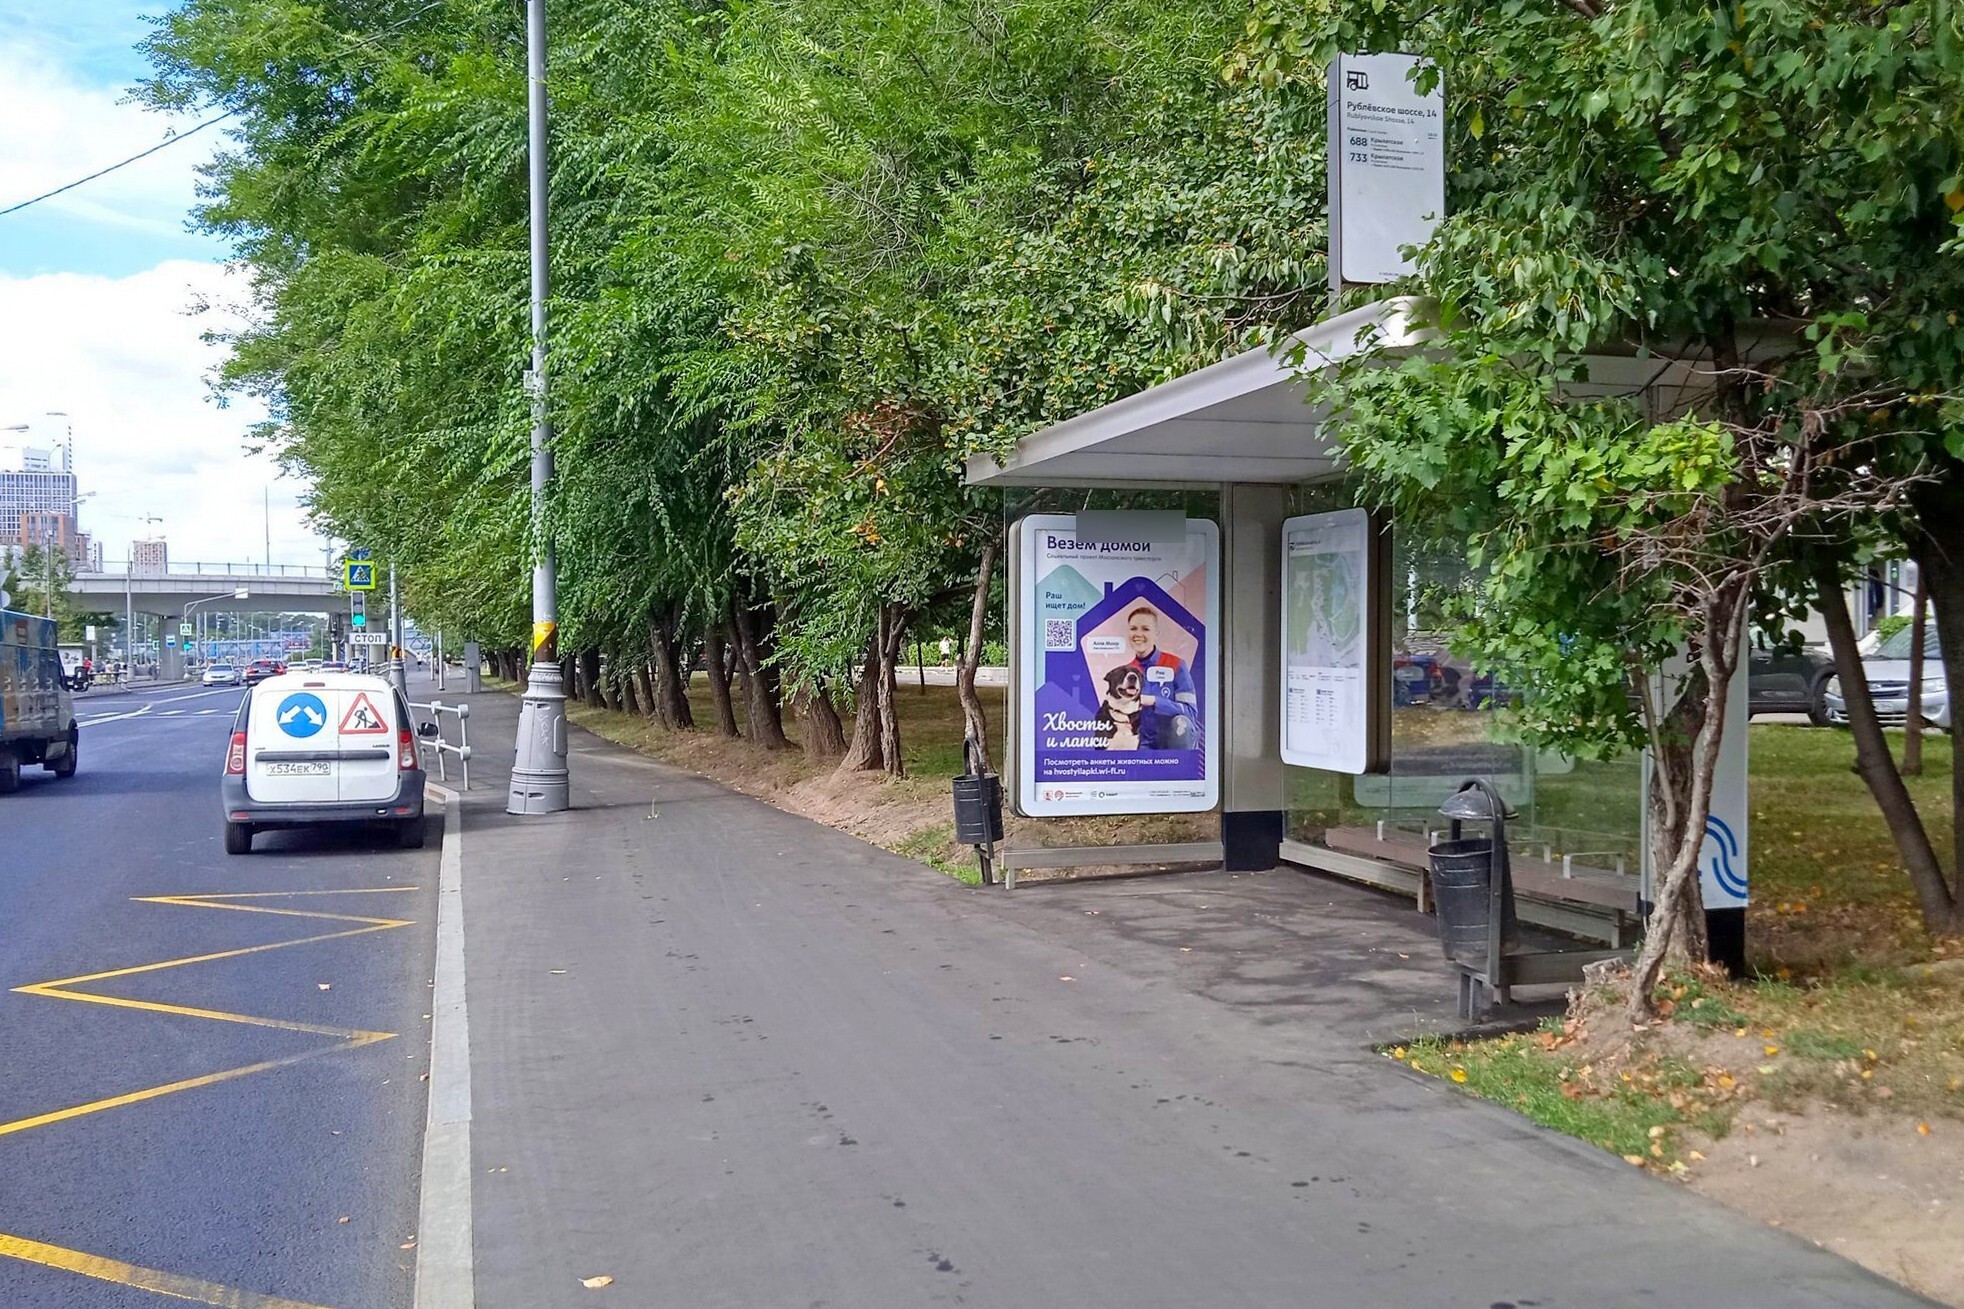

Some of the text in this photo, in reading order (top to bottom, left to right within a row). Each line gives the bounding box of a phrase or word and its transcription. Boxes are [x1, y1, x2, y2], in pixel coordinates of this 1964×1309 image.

[1347, 101, 1437, 118] Рублёвское шоссе, 14
[1350, 136, 1368, 147] 688
[1350, 152, 1368, 162] 733
[1047, 536, 1097, 551] Везем
[1046, 592, 1062, 600] Раш
[1046, 602, 1085, 610] ищет дом!
[355, 635, 382, 643] СТОП
[1043, 711, 1113, 731] Хвосты
[1046, 736, 1110, 748] и лапки
